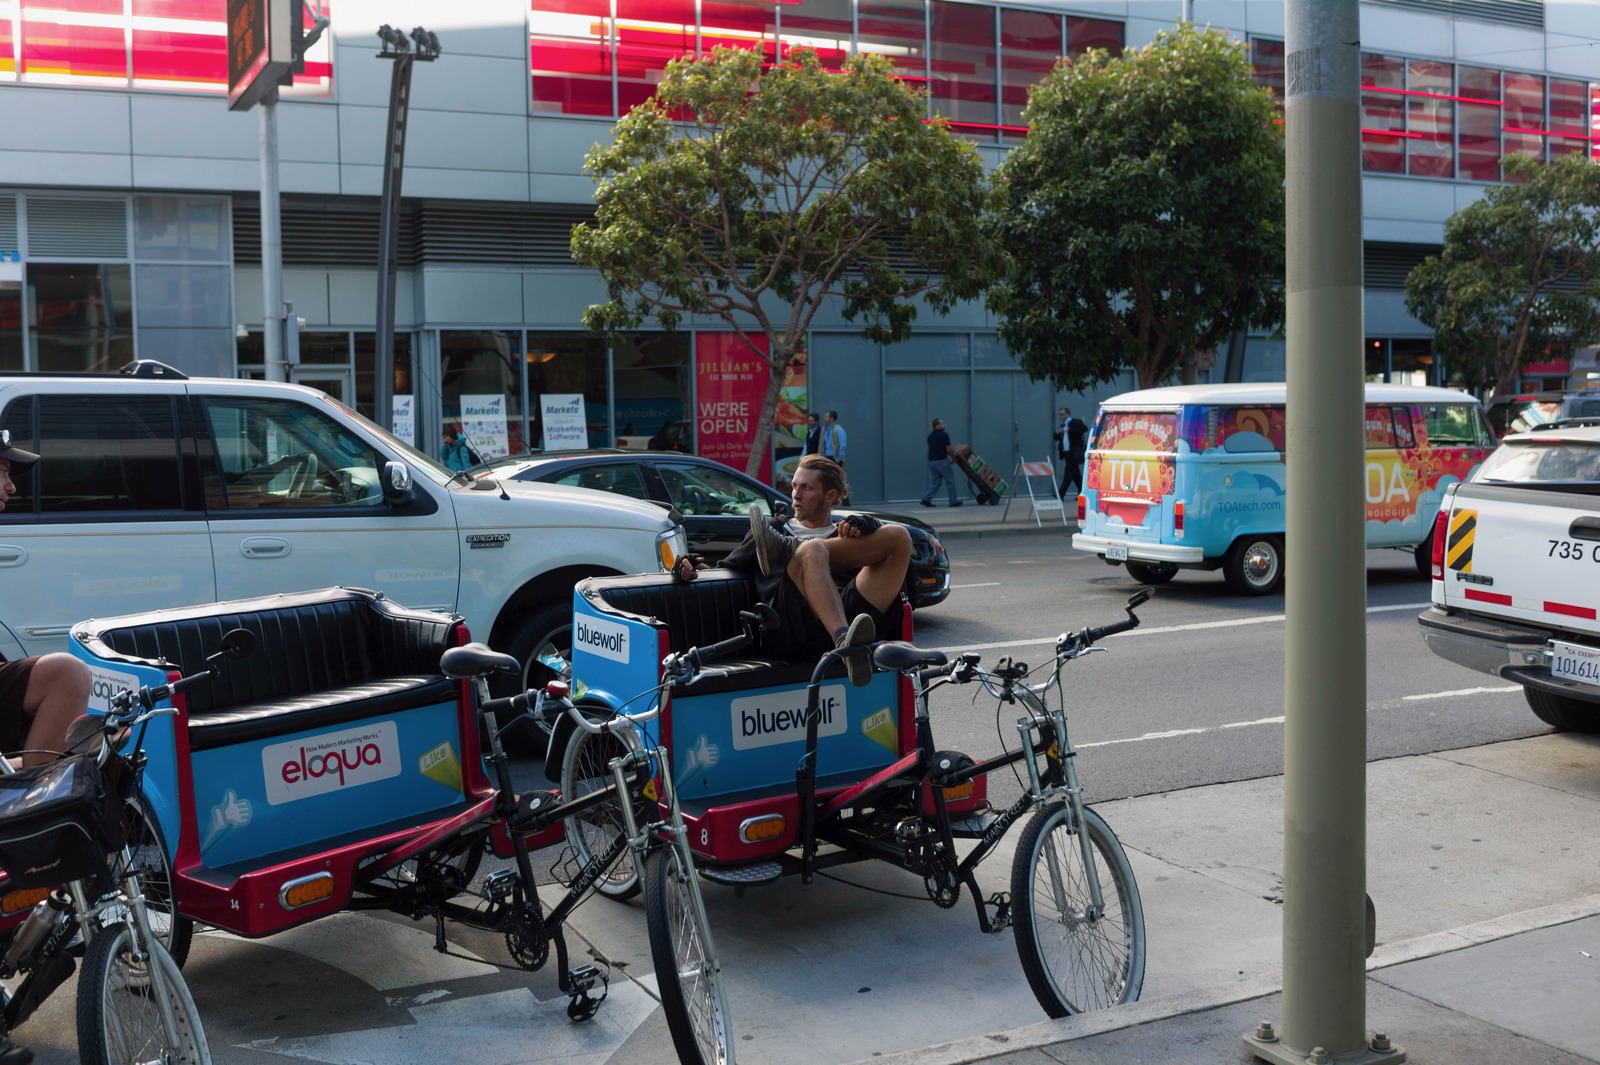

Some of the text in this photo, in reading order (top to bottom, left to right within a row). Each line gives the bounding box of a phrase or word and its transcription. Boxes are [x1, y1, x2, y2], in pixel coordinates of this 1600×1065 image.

[700, 361, 763, 374] JILLIAN'S
[465, 407, 499, 416] Marketo
[546, 406, 579, 415] Marketo
[699, 402, 750, 417] WE'RE
[547, 426, 584, 434] Marketing
[700, 419, 748, 434] OPEN
[1107, 458, 1152, 493] TOA
[1365, 462, 1411, 504] OA
[1218, 500, 1281, 513] TOAtech.com
[466, 534, 511, 542] EXPEDITION
[1548, 539, 1584, 561] 735
[1567, 648, 1599, 660] CA EXEMPT
[1555, 655, 1600, 681] 101614
[317, 741, 338, 750] Modern
[337, 735, 363, 746] Marketing
[281, 743, 382, 786] eloqua
[700, 827, 708, 845] 8
[230, 898, 240, 911] 14
